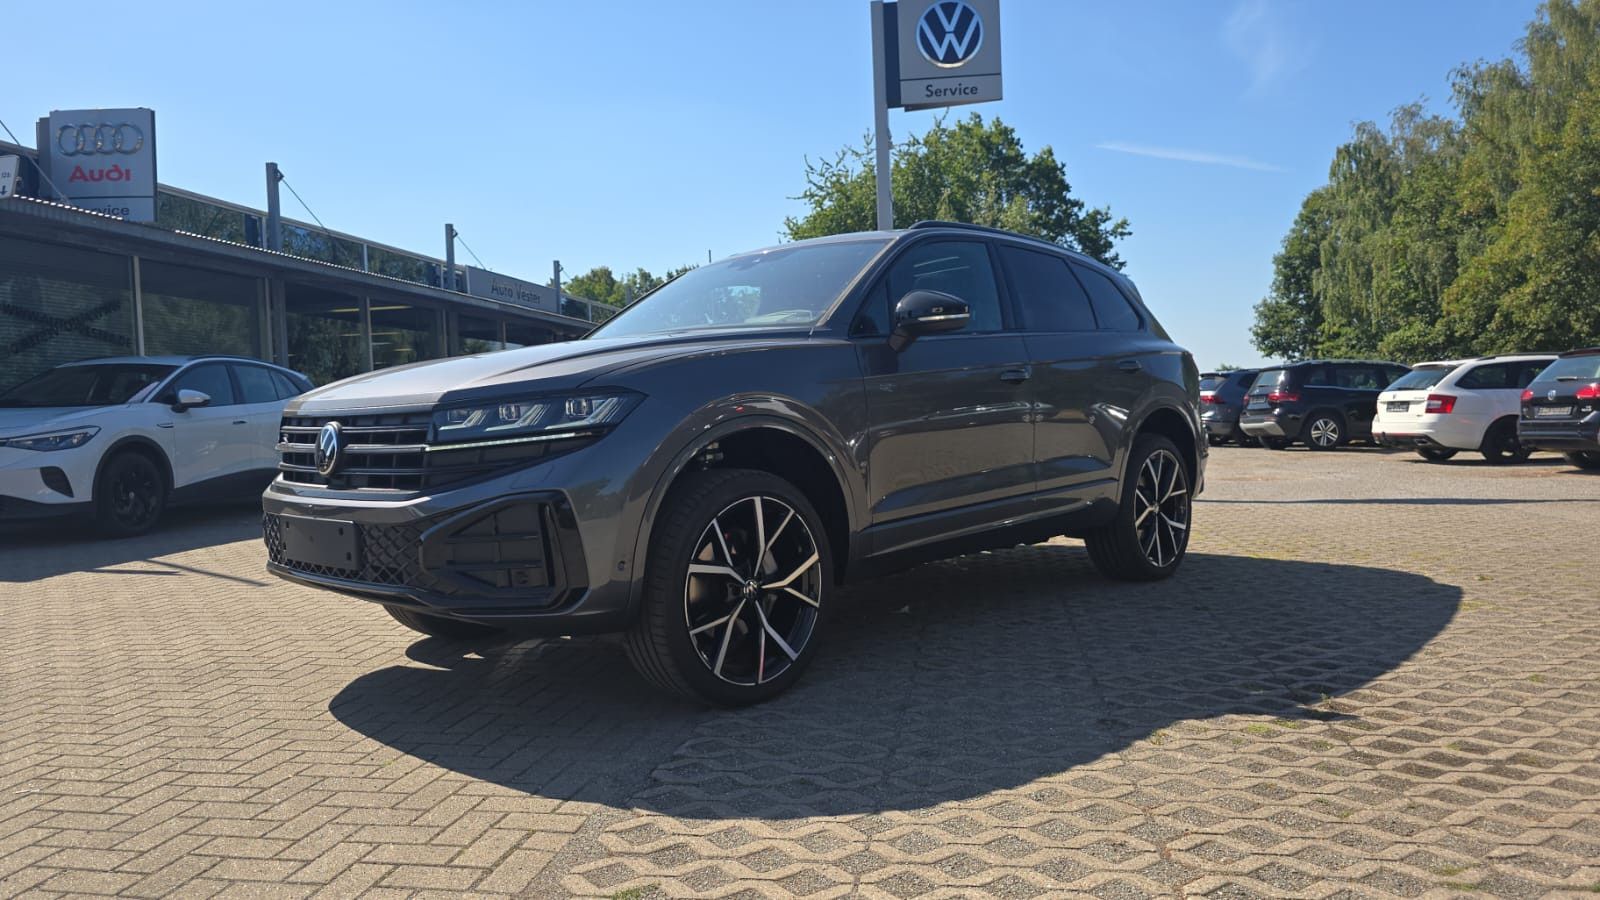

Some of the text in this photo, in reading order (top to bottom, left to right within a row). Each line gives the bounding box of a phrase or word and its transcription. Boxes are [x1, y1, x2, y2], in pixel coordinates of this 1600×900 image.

[925, 83, 979, 98] Service
[68, 164, 132, 183] Audi
[490, 279, 513, 299] Auto
